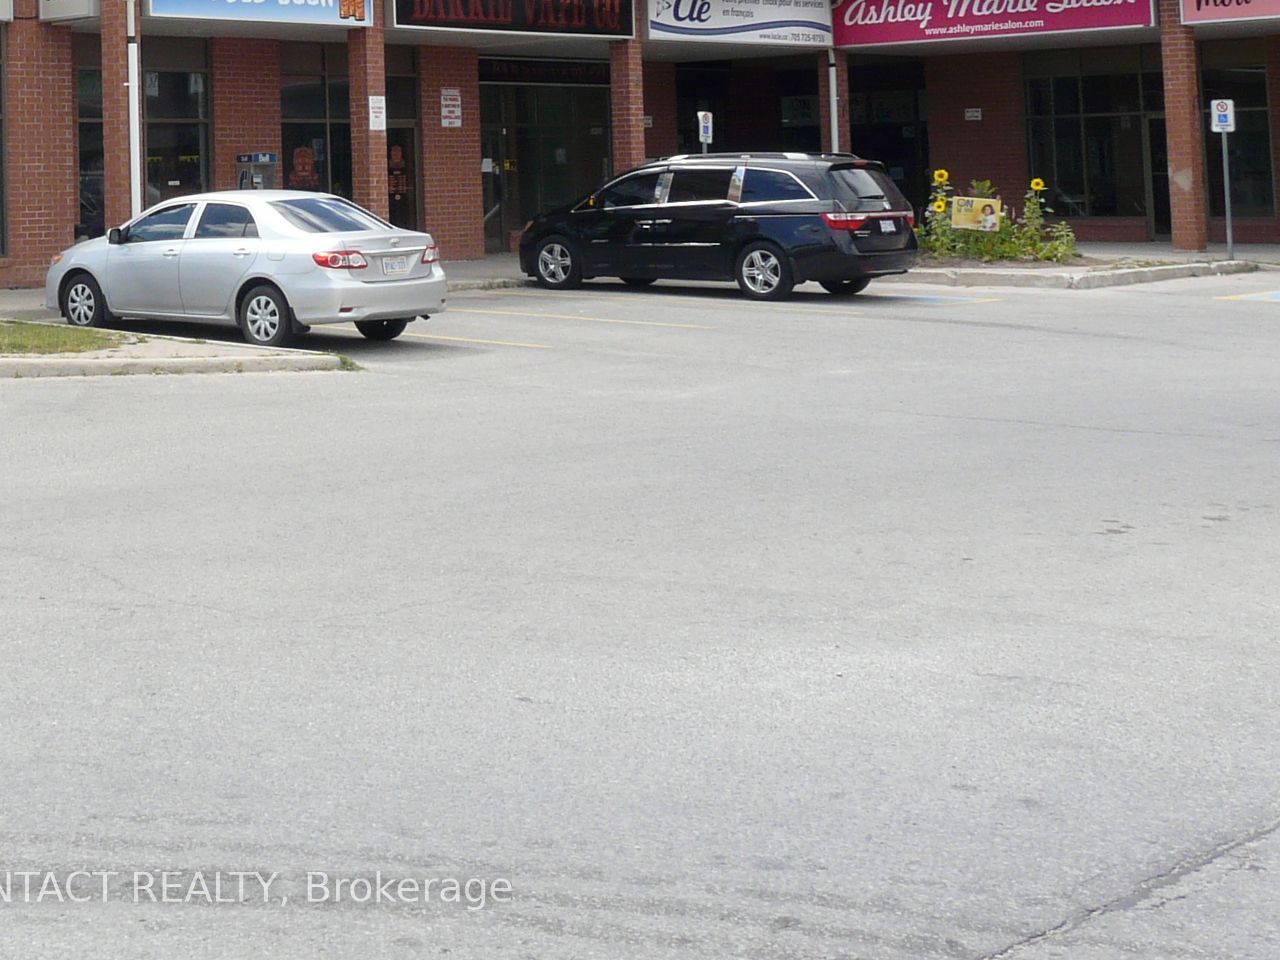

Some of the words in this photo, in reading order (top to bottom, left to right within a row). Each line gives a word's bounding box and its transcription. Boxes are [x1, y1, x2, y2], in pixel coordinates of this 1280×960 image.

[778, 0, 792, 8] pour
[801, 0, 824, 8] services
[722, 8, 730, 17] en
[924, 19, 1044, 36] www.ashleymariesalon.com
